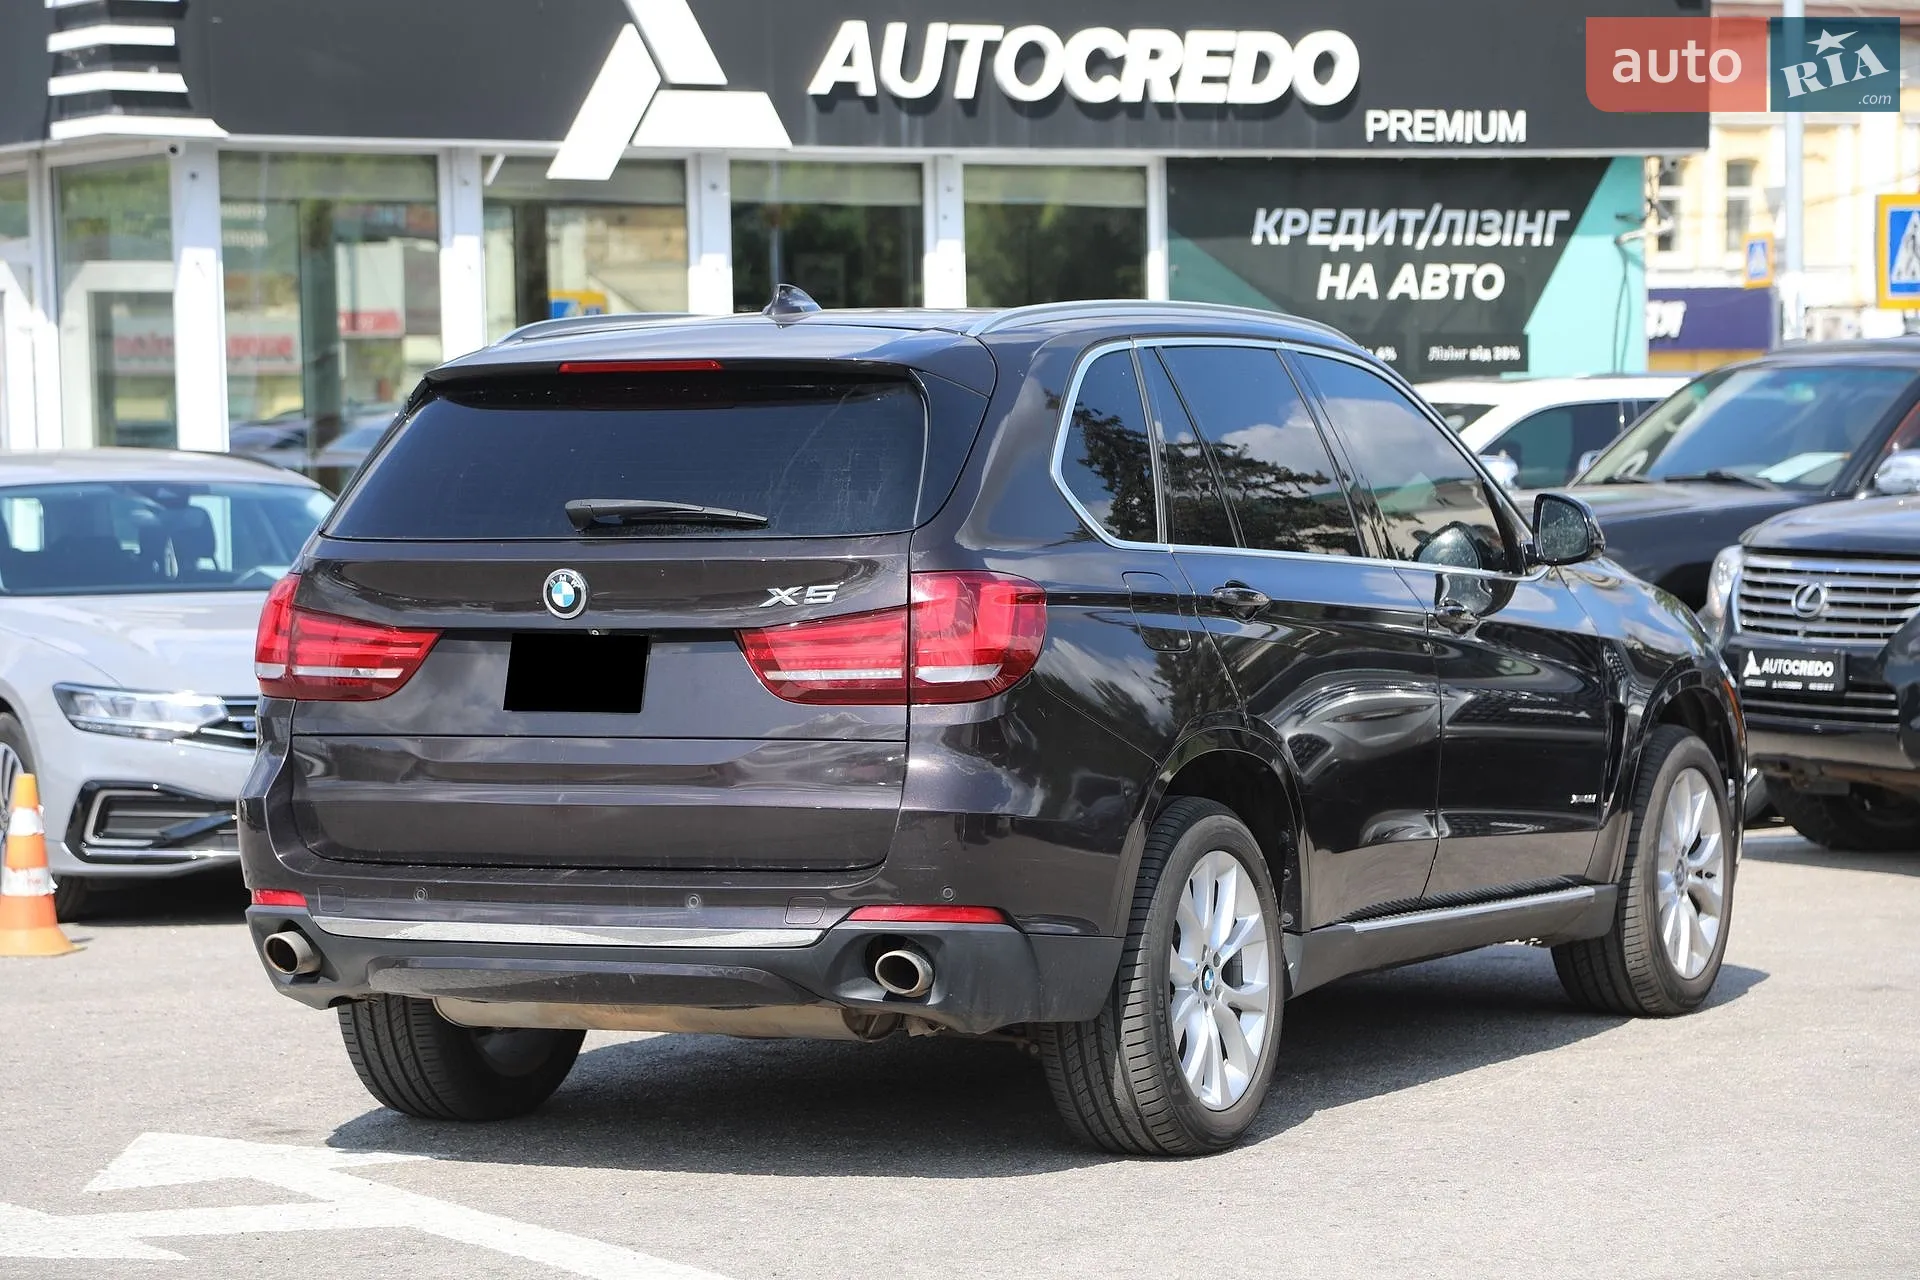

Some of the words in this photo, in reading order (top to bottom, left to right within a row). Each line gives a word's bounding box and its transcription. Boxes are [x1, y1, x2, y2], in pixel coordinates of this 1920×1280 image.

[807, 20, 1359, 106] AUTOCREDO
[1365, 109, 1527, 143] PREMIUM
[1251, 202, 1571, 252] КРЕДИТ/ЛІЗІНГ
[1316, 262, 1379, 300] НА
[1387, 262, 1506, 300] АВТО
[758, 584, 840, 608] X5
[1761, 657, 1834, 677] AUTOCREDO
